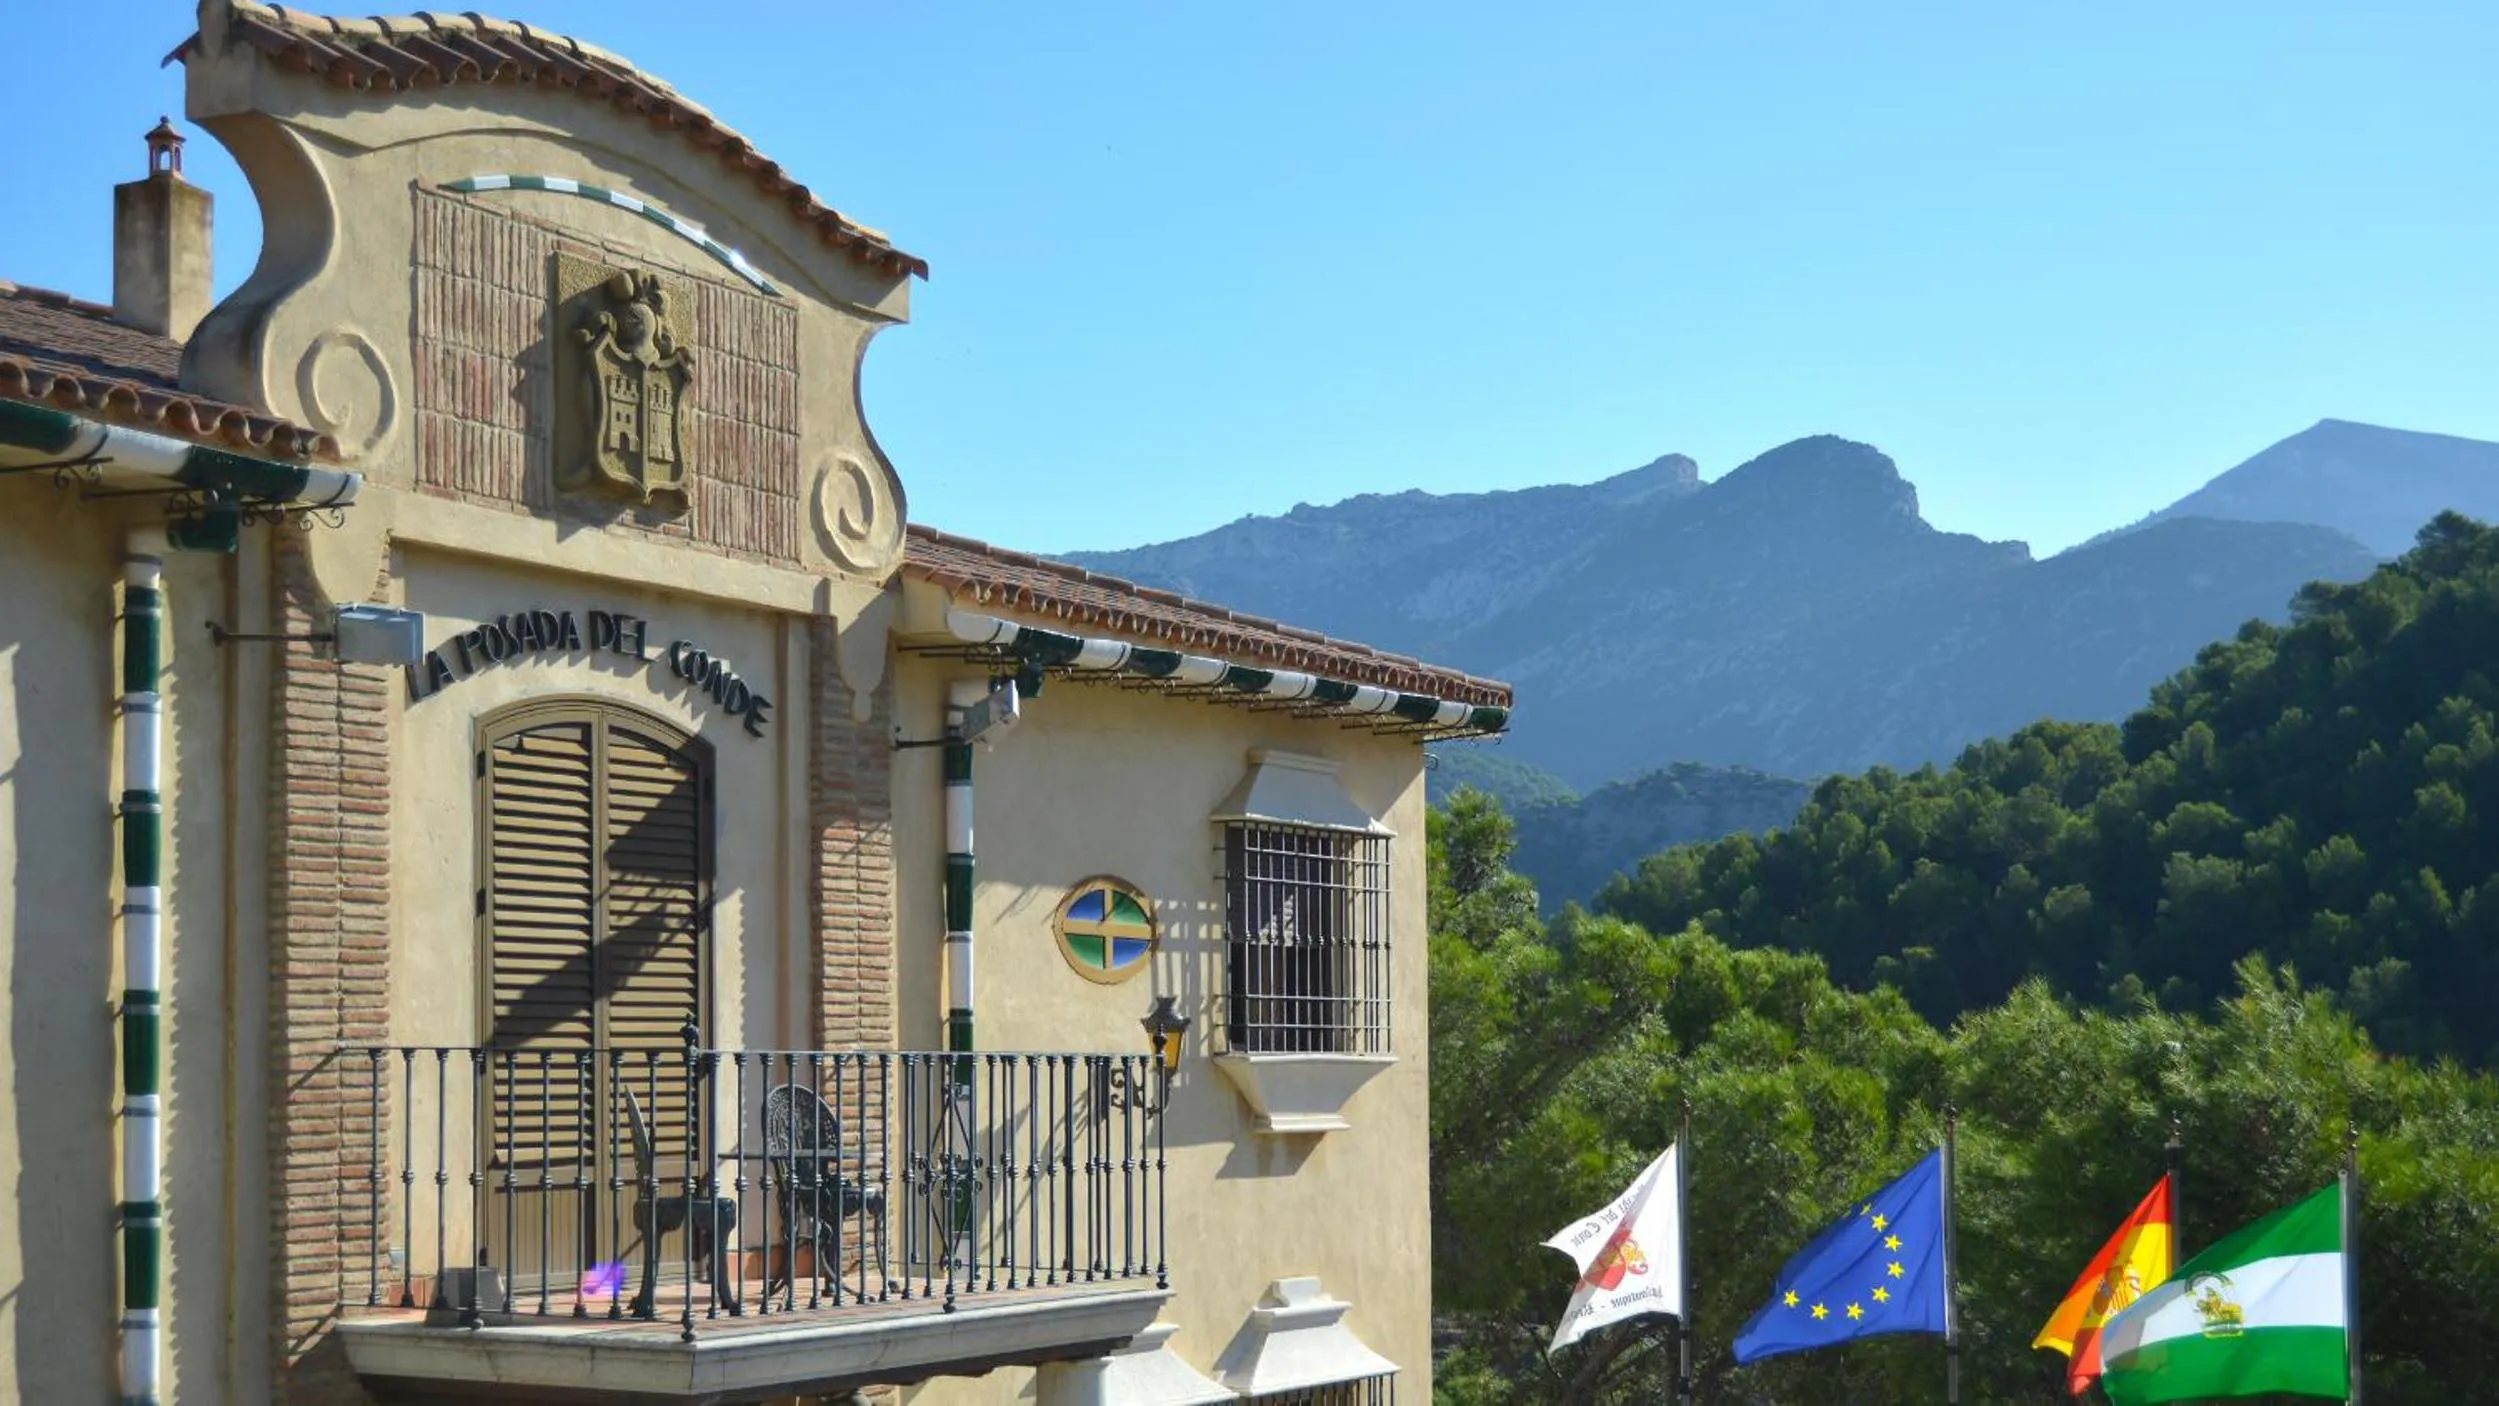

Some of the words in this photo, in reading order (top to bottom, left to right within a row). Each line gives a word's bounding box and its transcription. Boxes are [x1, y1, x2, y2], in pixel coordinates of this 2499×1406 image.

[405, 650, 456, 702] LA
[456, 609, 581, 674] POSADA
[589, 609, 661, 663] DEL
[669, 639, 774, 738] CONDE
